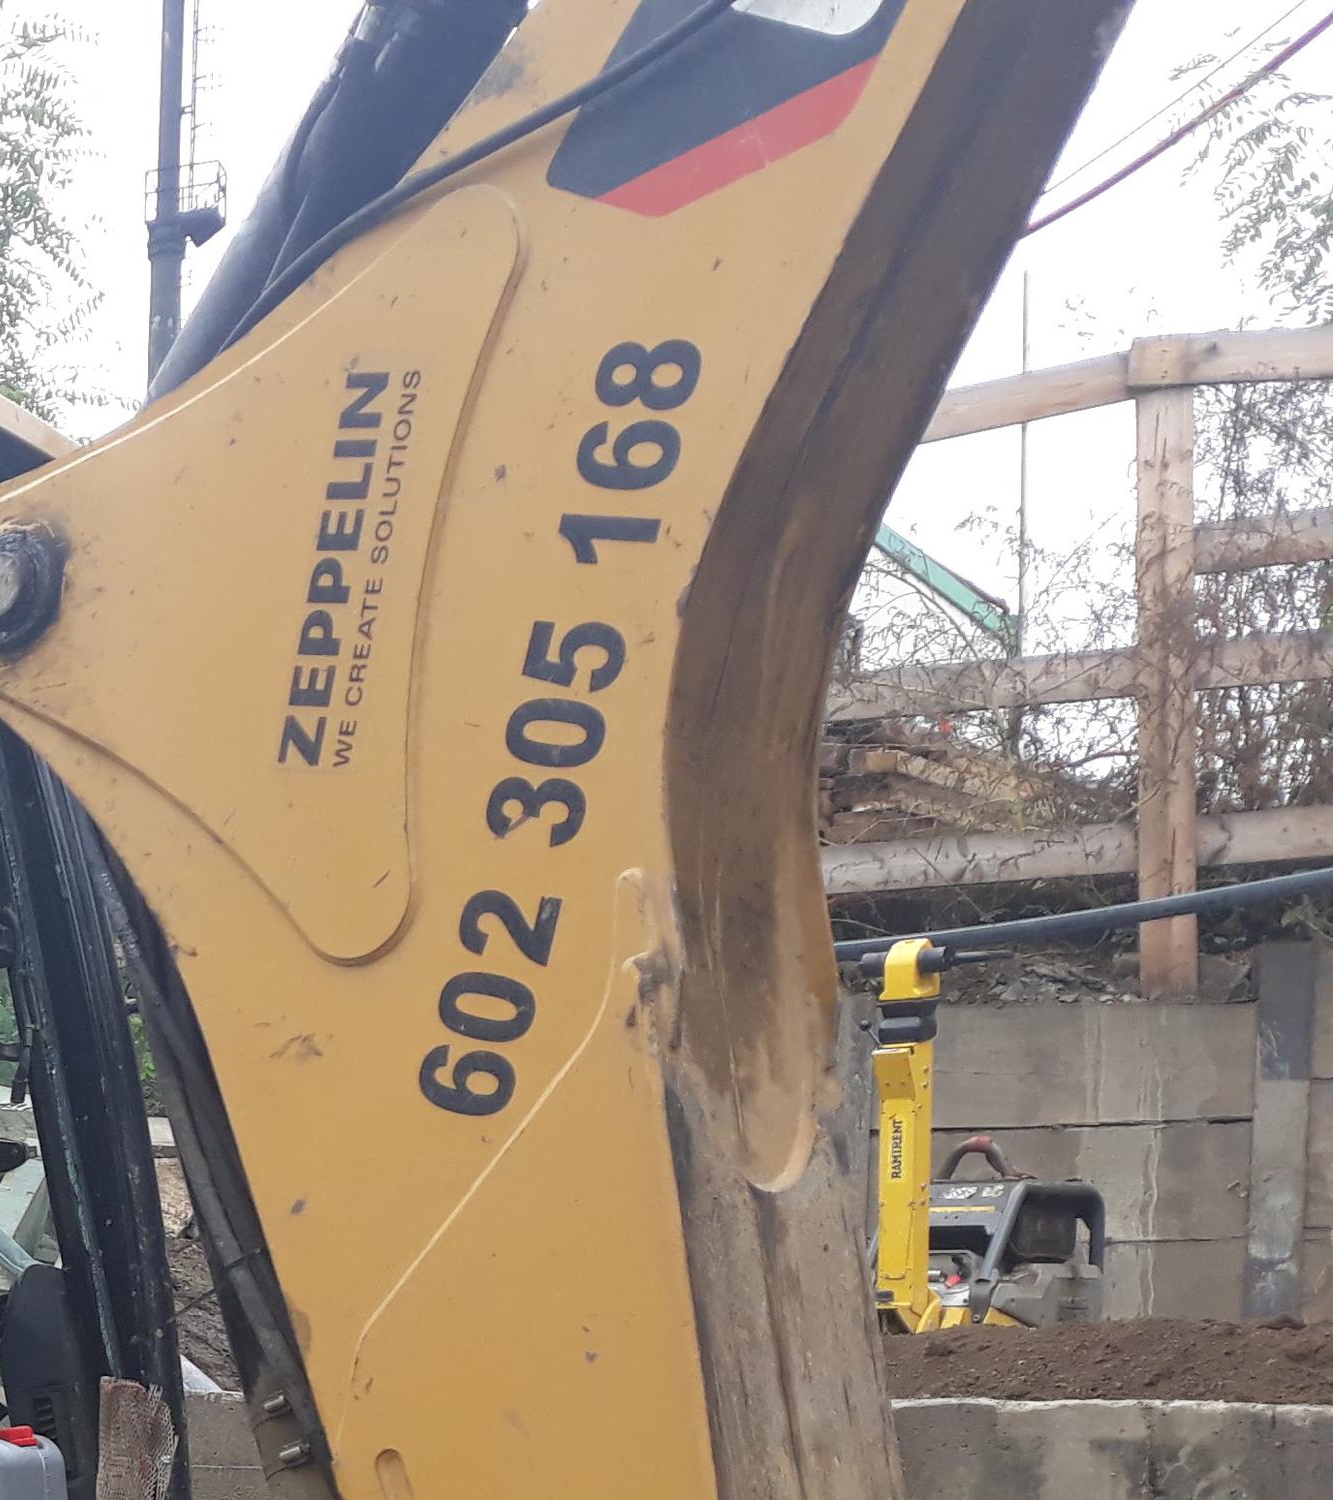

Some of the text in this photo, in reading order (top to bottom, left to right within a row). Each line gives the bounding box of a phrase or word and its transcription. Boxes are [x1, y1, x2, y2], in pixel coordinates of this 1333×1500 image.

[278, 371, 391, 768] ZEPPELIN
[333, 369, 421, 768] WE CREATE SOLUTIONS
[418, 338, 703, 1117] 602 305 168
[890, 1119, 903, 1179] RAMIRENT
